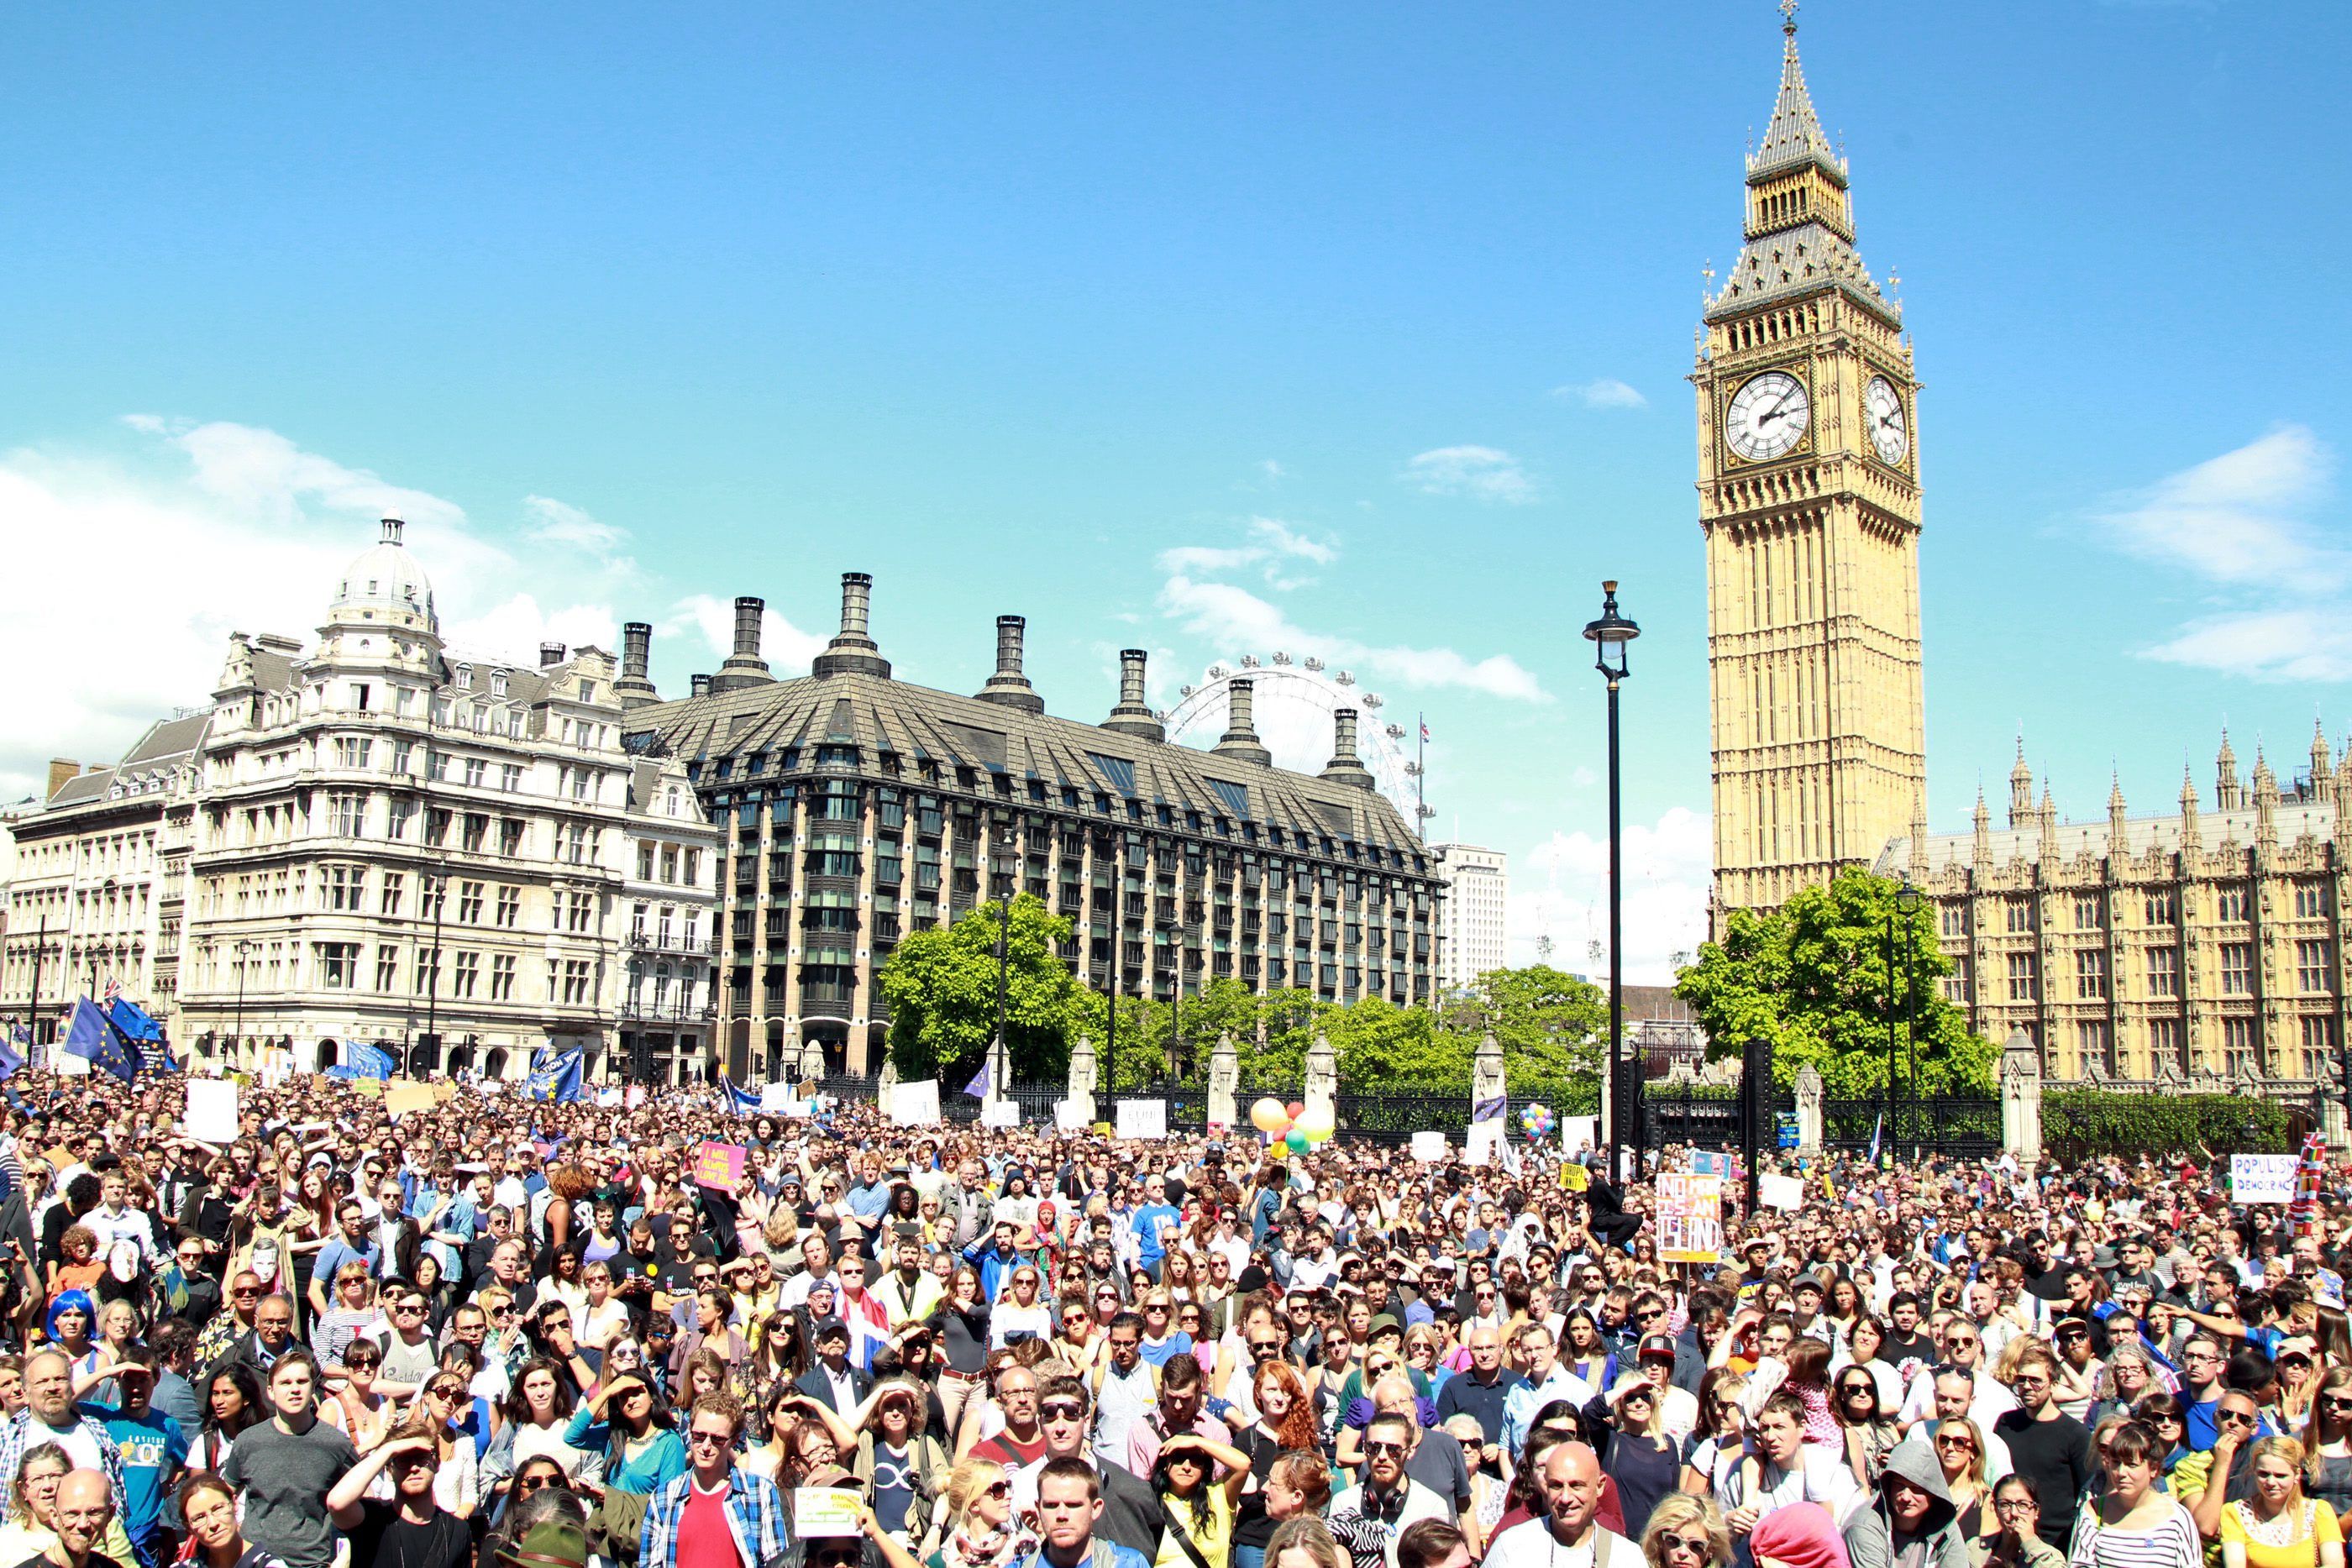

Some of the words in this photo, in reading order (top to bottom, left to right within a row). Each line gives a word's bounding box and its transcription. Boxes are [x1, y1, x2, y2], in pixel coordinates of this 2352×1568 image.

[705, 1147, 710, 1158] I
[711, 1148, 729, 1161] WILL
[701, 1159, 729, 1175] ALWAYS
[2235, 1157, 2297, 1174] POPULISM
[699, 1170, 717, 1183] LOVE
[2238, 1178, 2292, 1191] DEMOCRAC
[1661, 1177, 1686, 1198] NO
[1689, 1178, 1720, 1197] MAN
[1657, 1198, 1686, 1216] IS
[1693, 1198, 1715, 1216] AN
[1657, 1217, 1719, 1251] ISLAND
